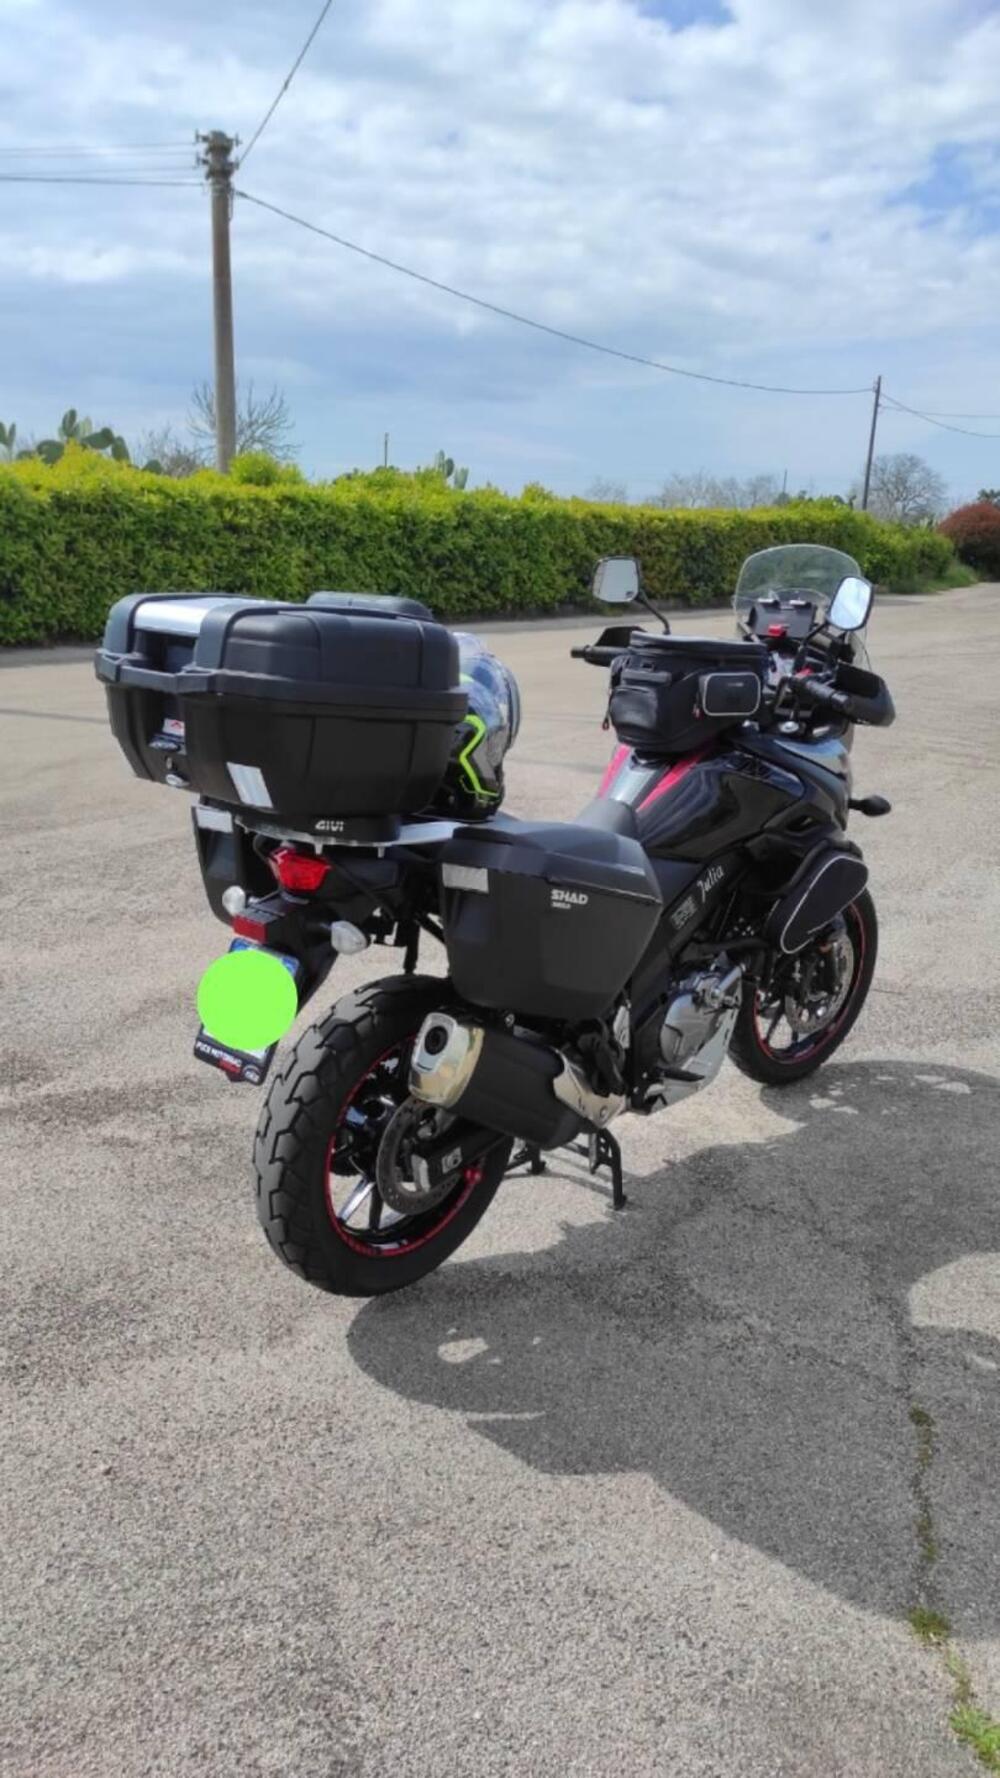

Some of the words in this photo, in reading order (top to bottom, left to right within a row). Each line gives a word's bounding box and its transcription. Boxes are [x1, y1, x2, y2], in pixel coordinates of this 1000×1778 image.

[315, 819, 344, 831] GIVI
[697, 865, 724, 903] Julia
[551, 889, 588, 905] SHAD
